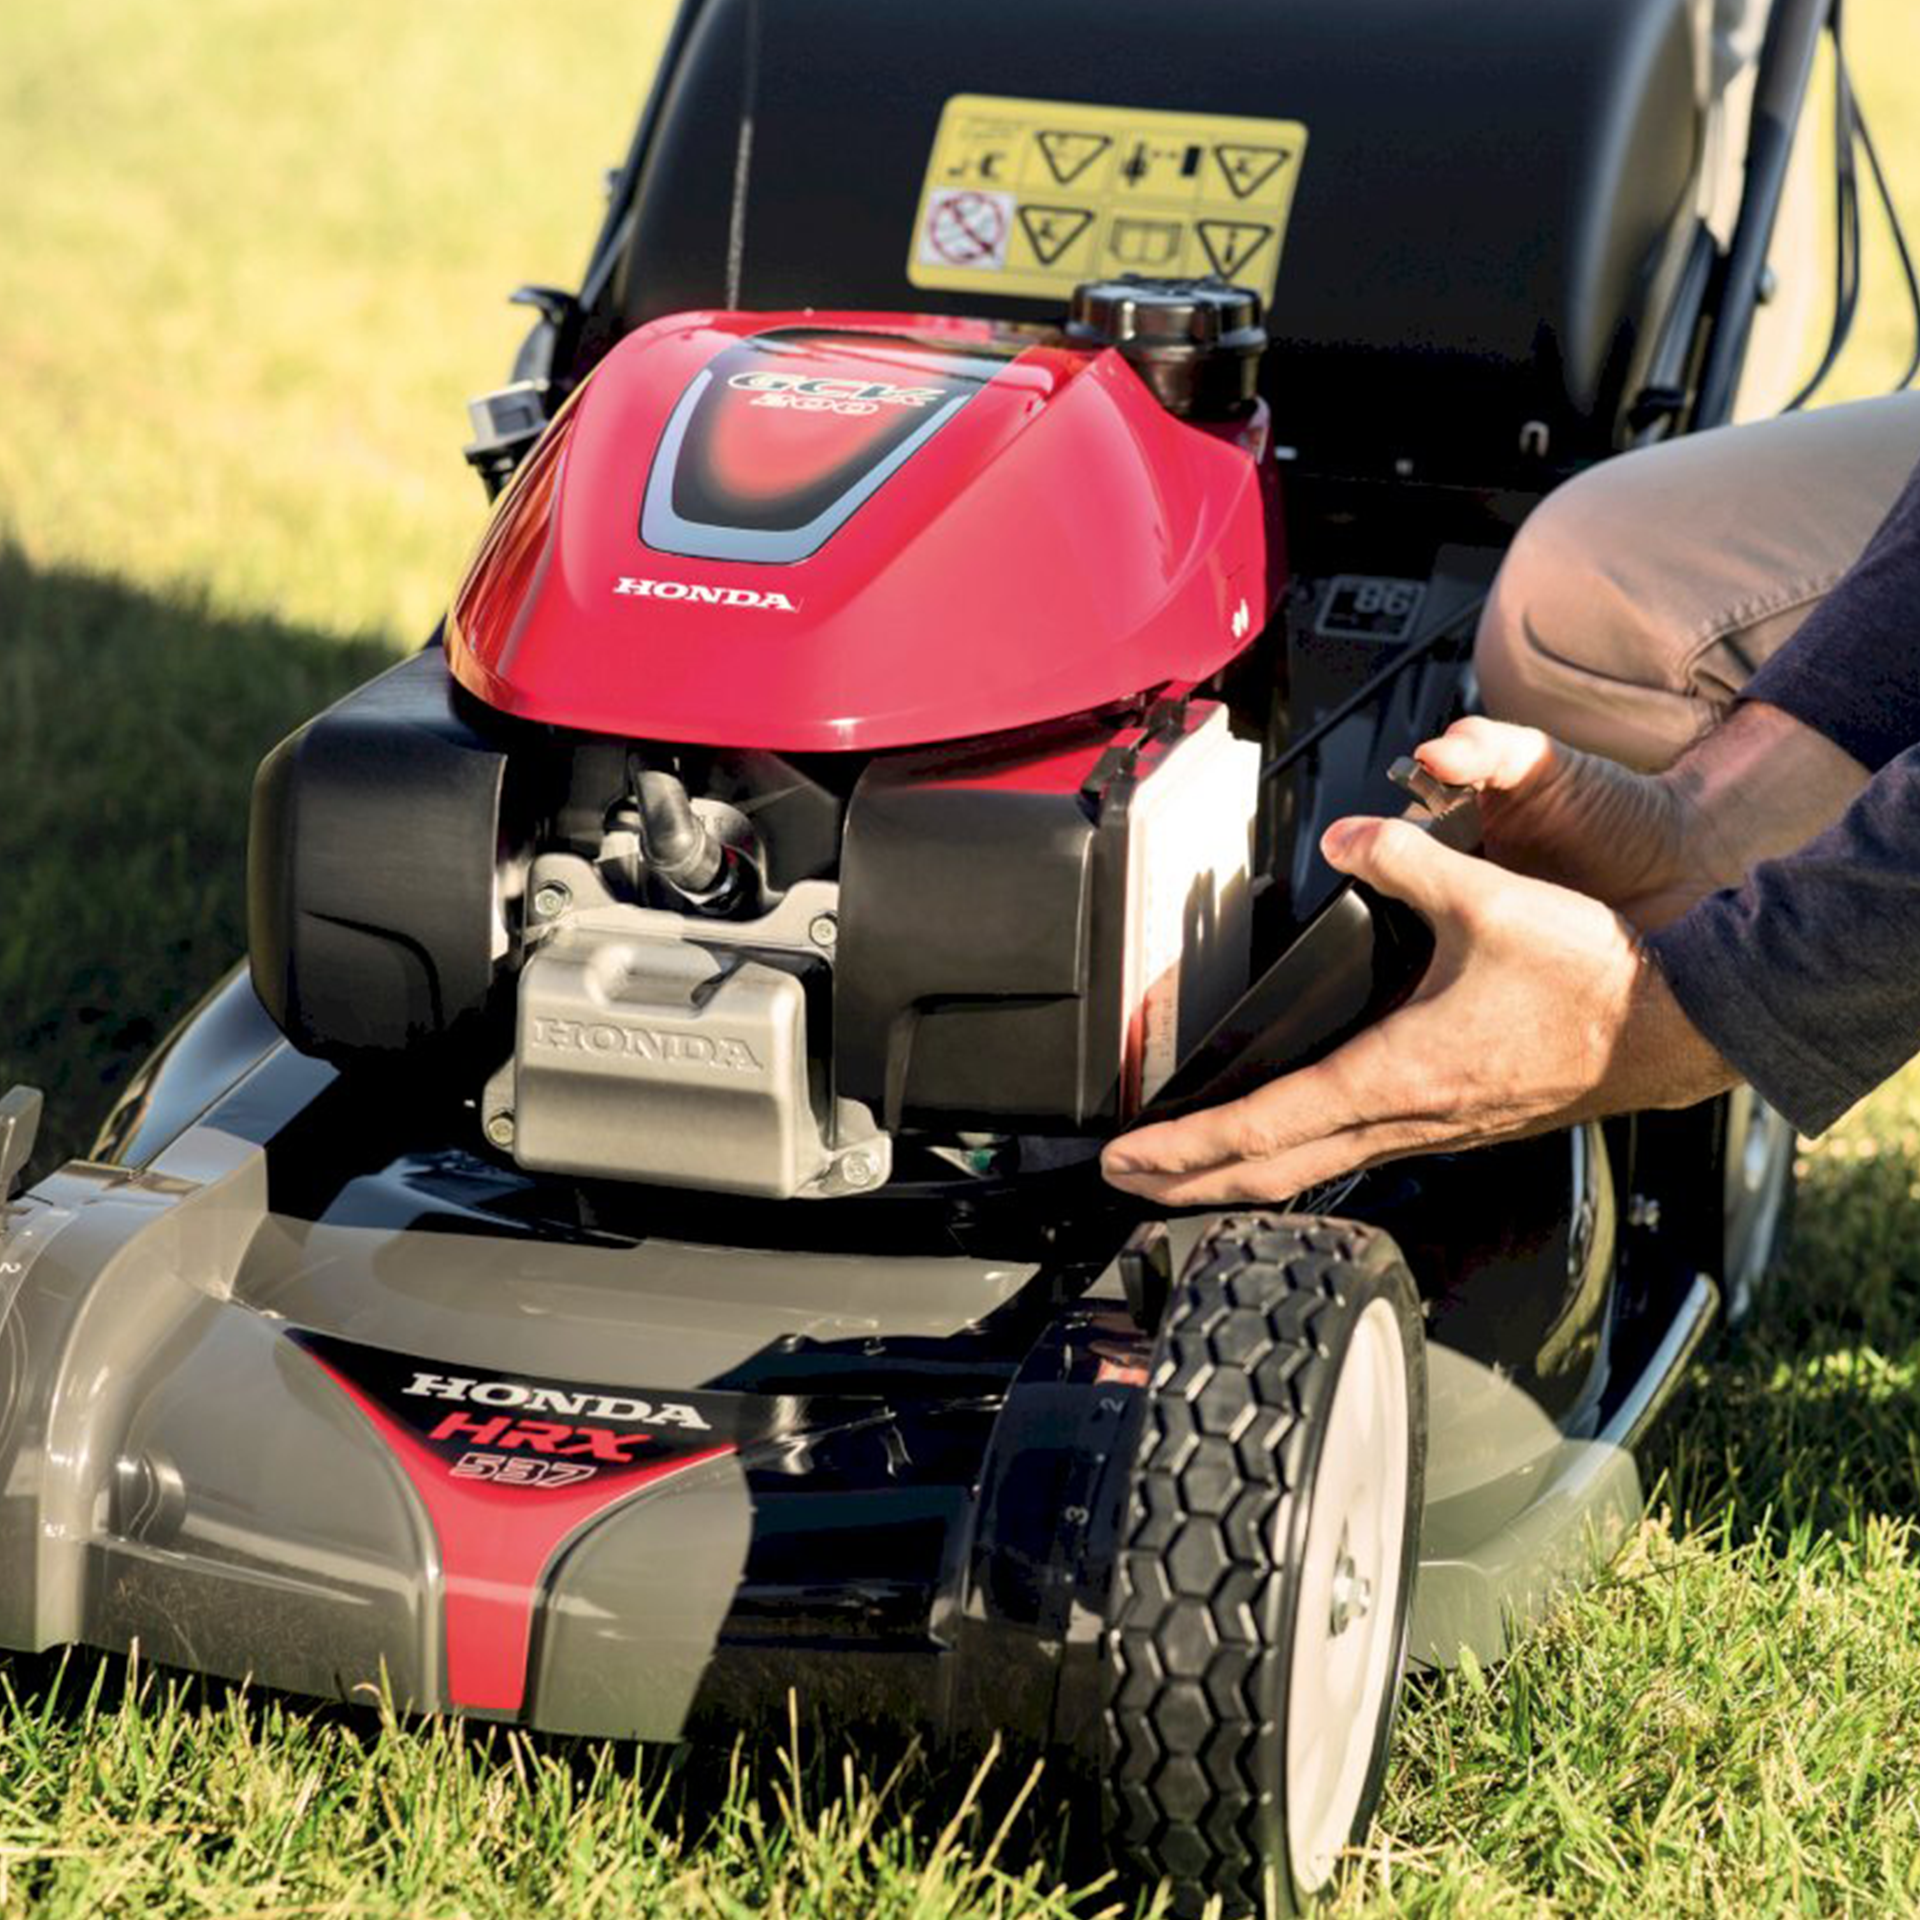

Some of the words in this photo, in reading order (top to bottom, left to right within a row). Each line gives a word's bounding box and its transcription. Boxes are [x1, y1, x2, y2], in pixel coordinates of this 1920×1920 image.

[612, 577, 796, 611] HONDA
[531, 1016, 764, 1074] HONDA
[402, 1372, 712, 1431] HONDA
[429, 1411, 657, 1463] HRX
[449, 1452, 597, 1487] 537
[1064, 1504, 1090, 1526] 3
